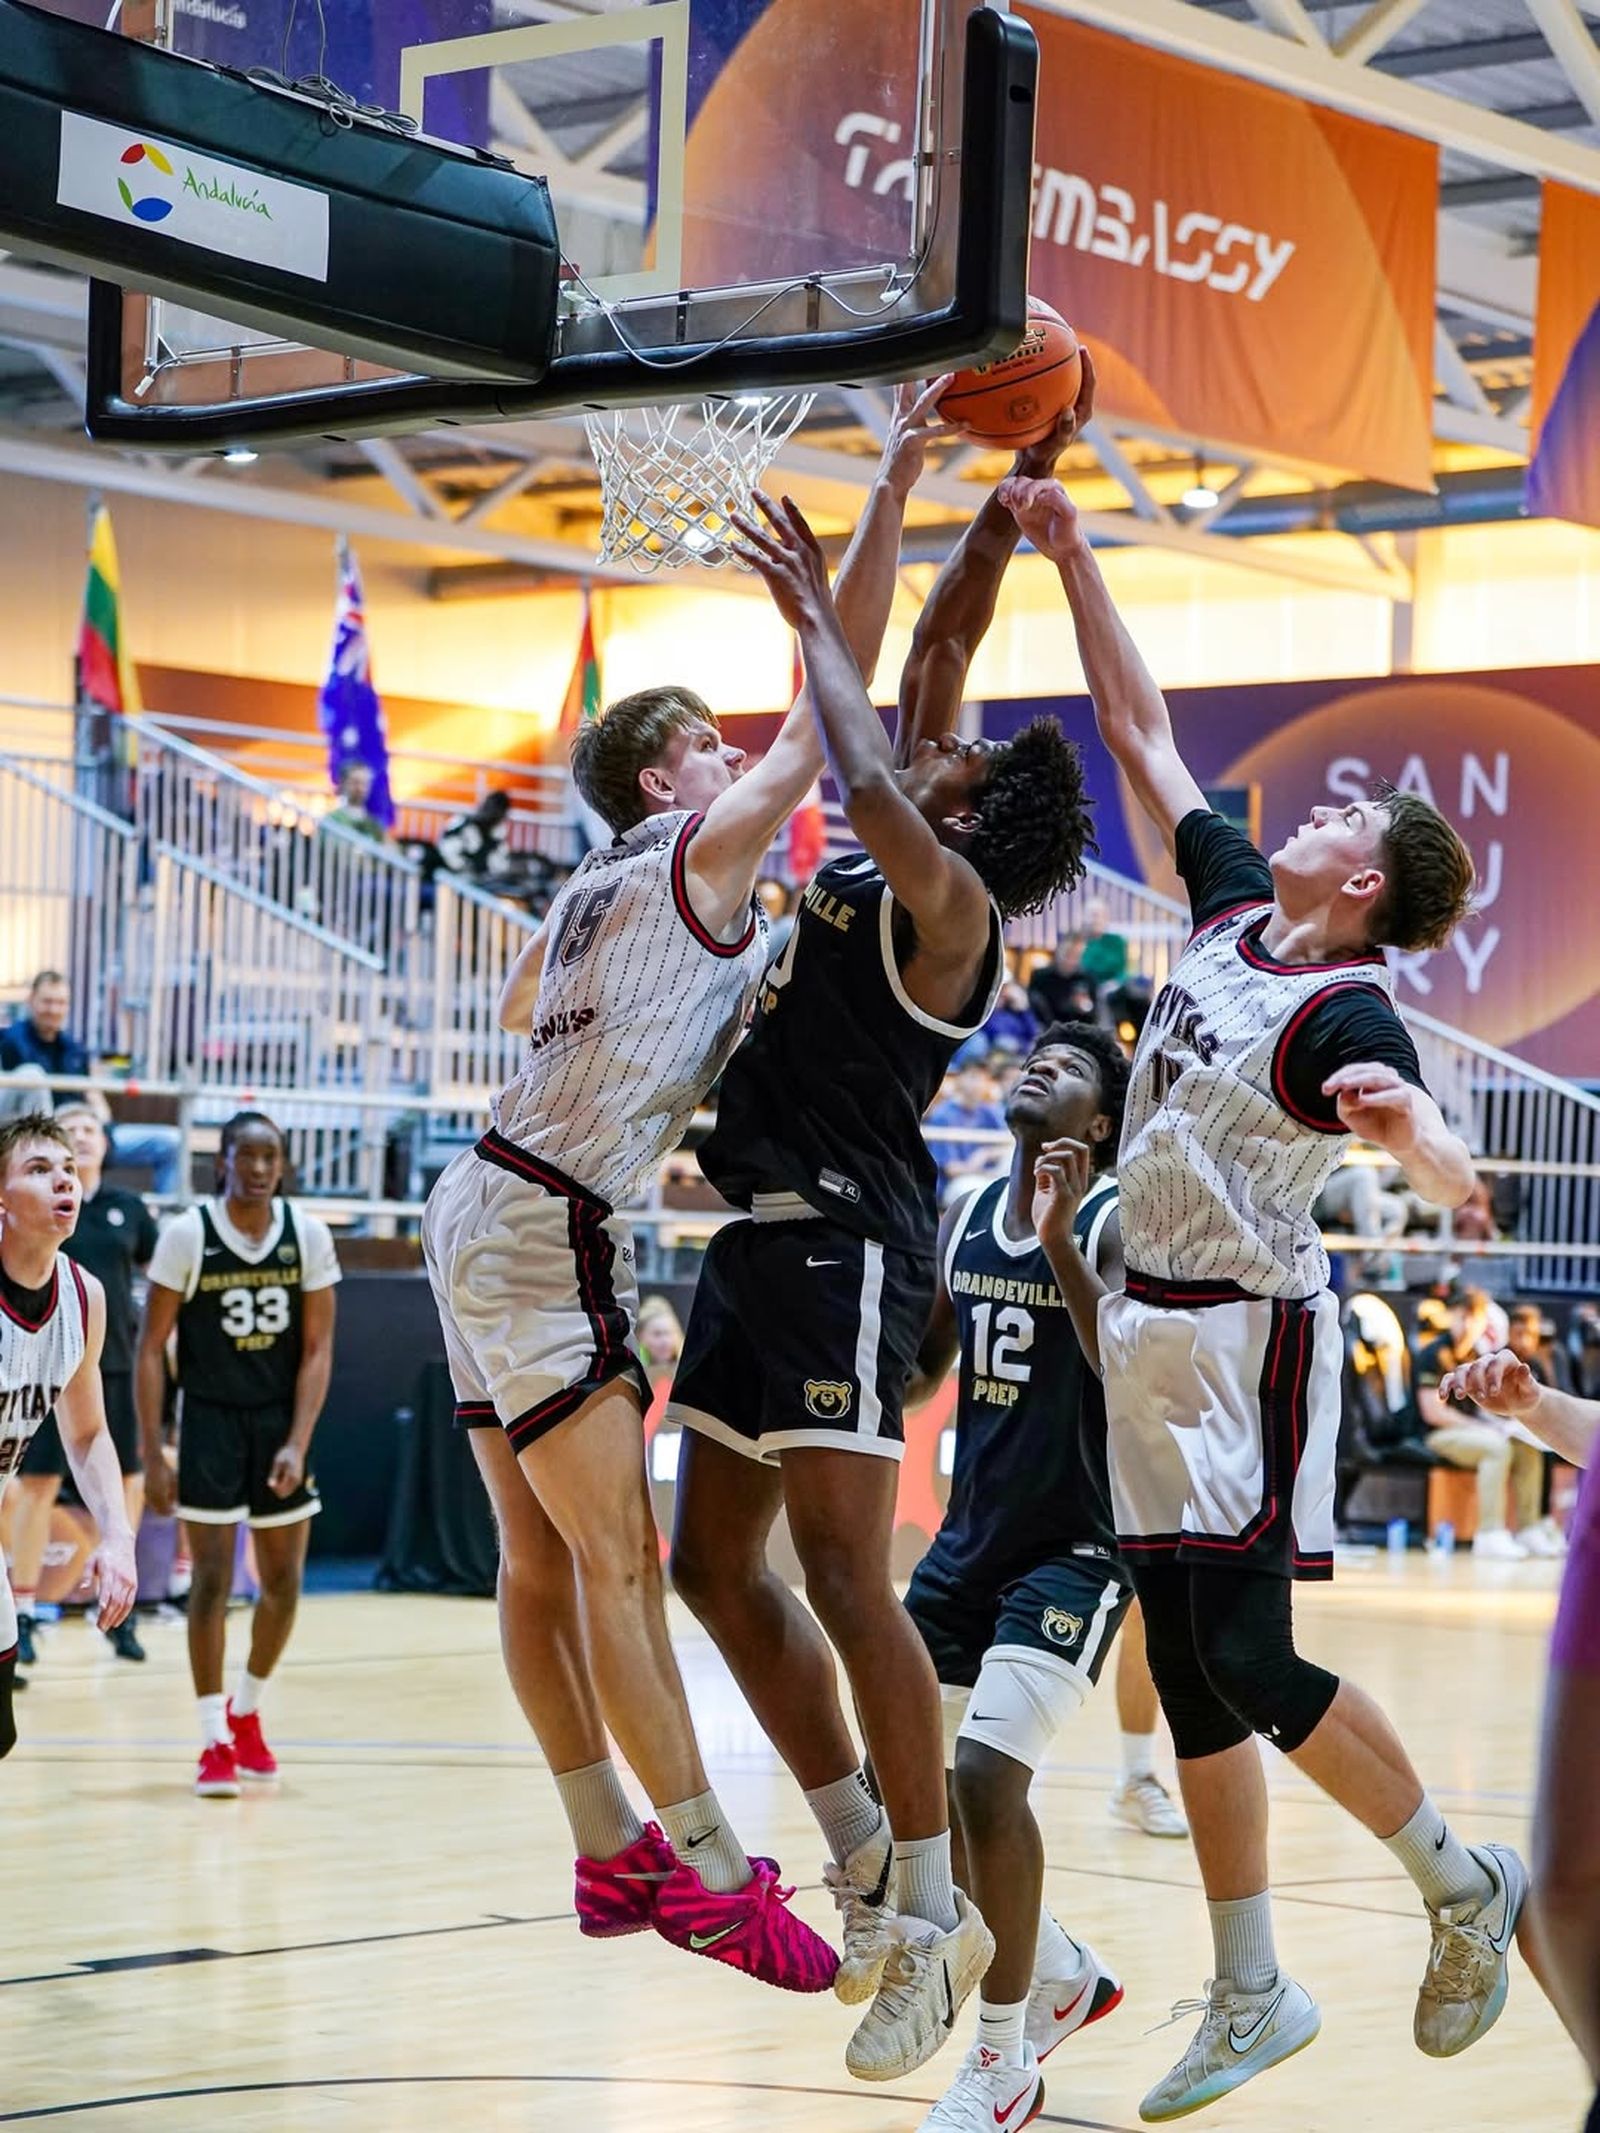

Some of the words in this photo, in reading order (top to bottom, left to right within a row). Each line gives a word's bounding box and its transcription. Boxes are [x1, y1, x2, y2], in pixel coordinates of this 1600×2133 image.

[182, 165, 274, 221] Andalucía
[1031, 162, 1295, 302] MBASSY
[1326, 753, 1509, 818] SAN
[545, 877, 623, 977] 15
[844, 1184, 857, 1198] XL
[220, 1286, 290, 1337] 33
[952, 1270, 1068, 1308] ORANGEVILL
[971, 1302, 1035, 1383] 12
[972, 1379, 1020, 1408] PREP
